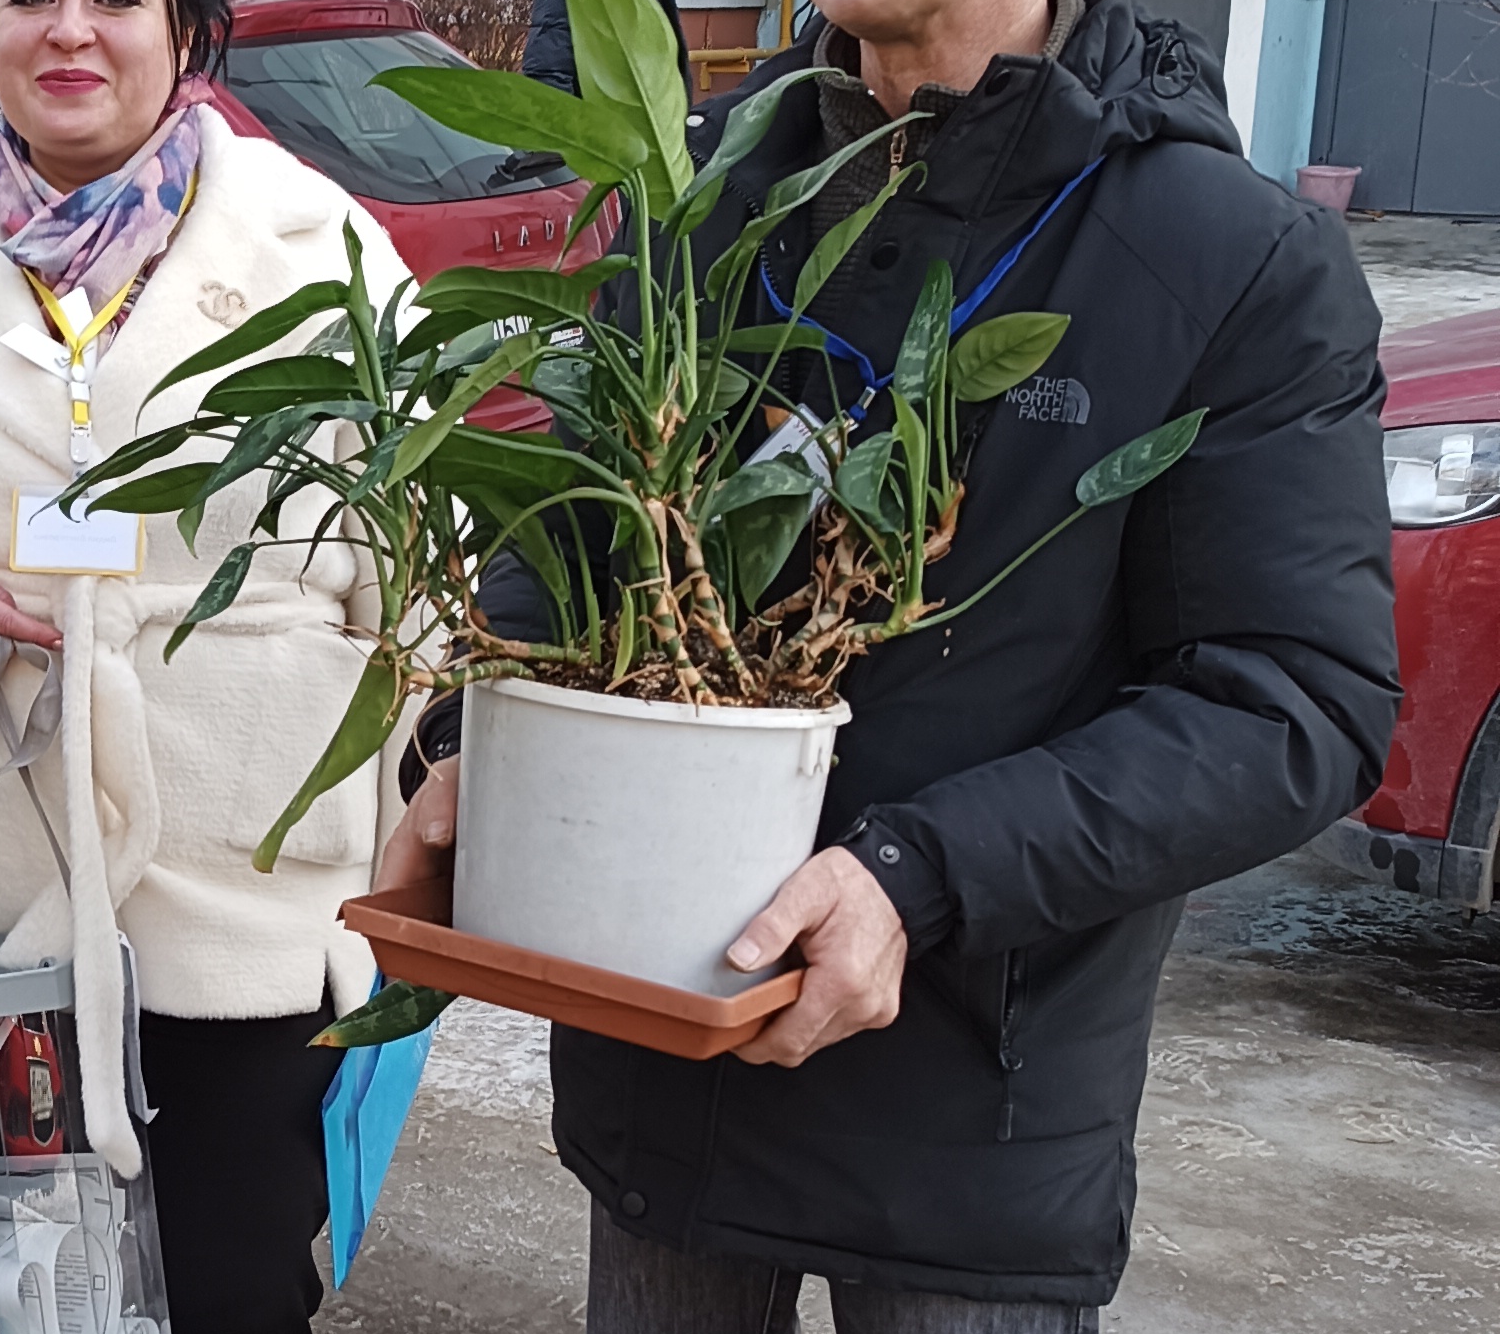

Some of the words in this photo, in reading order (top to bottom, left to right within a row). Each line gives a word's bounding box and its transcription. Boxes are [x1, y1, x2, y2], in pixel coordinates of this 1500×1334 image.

[1033, 375, 1067, 394] THE
[1005, 388, 1064, 408] NORTH
[1018, 404, 1061, 422] FACE
